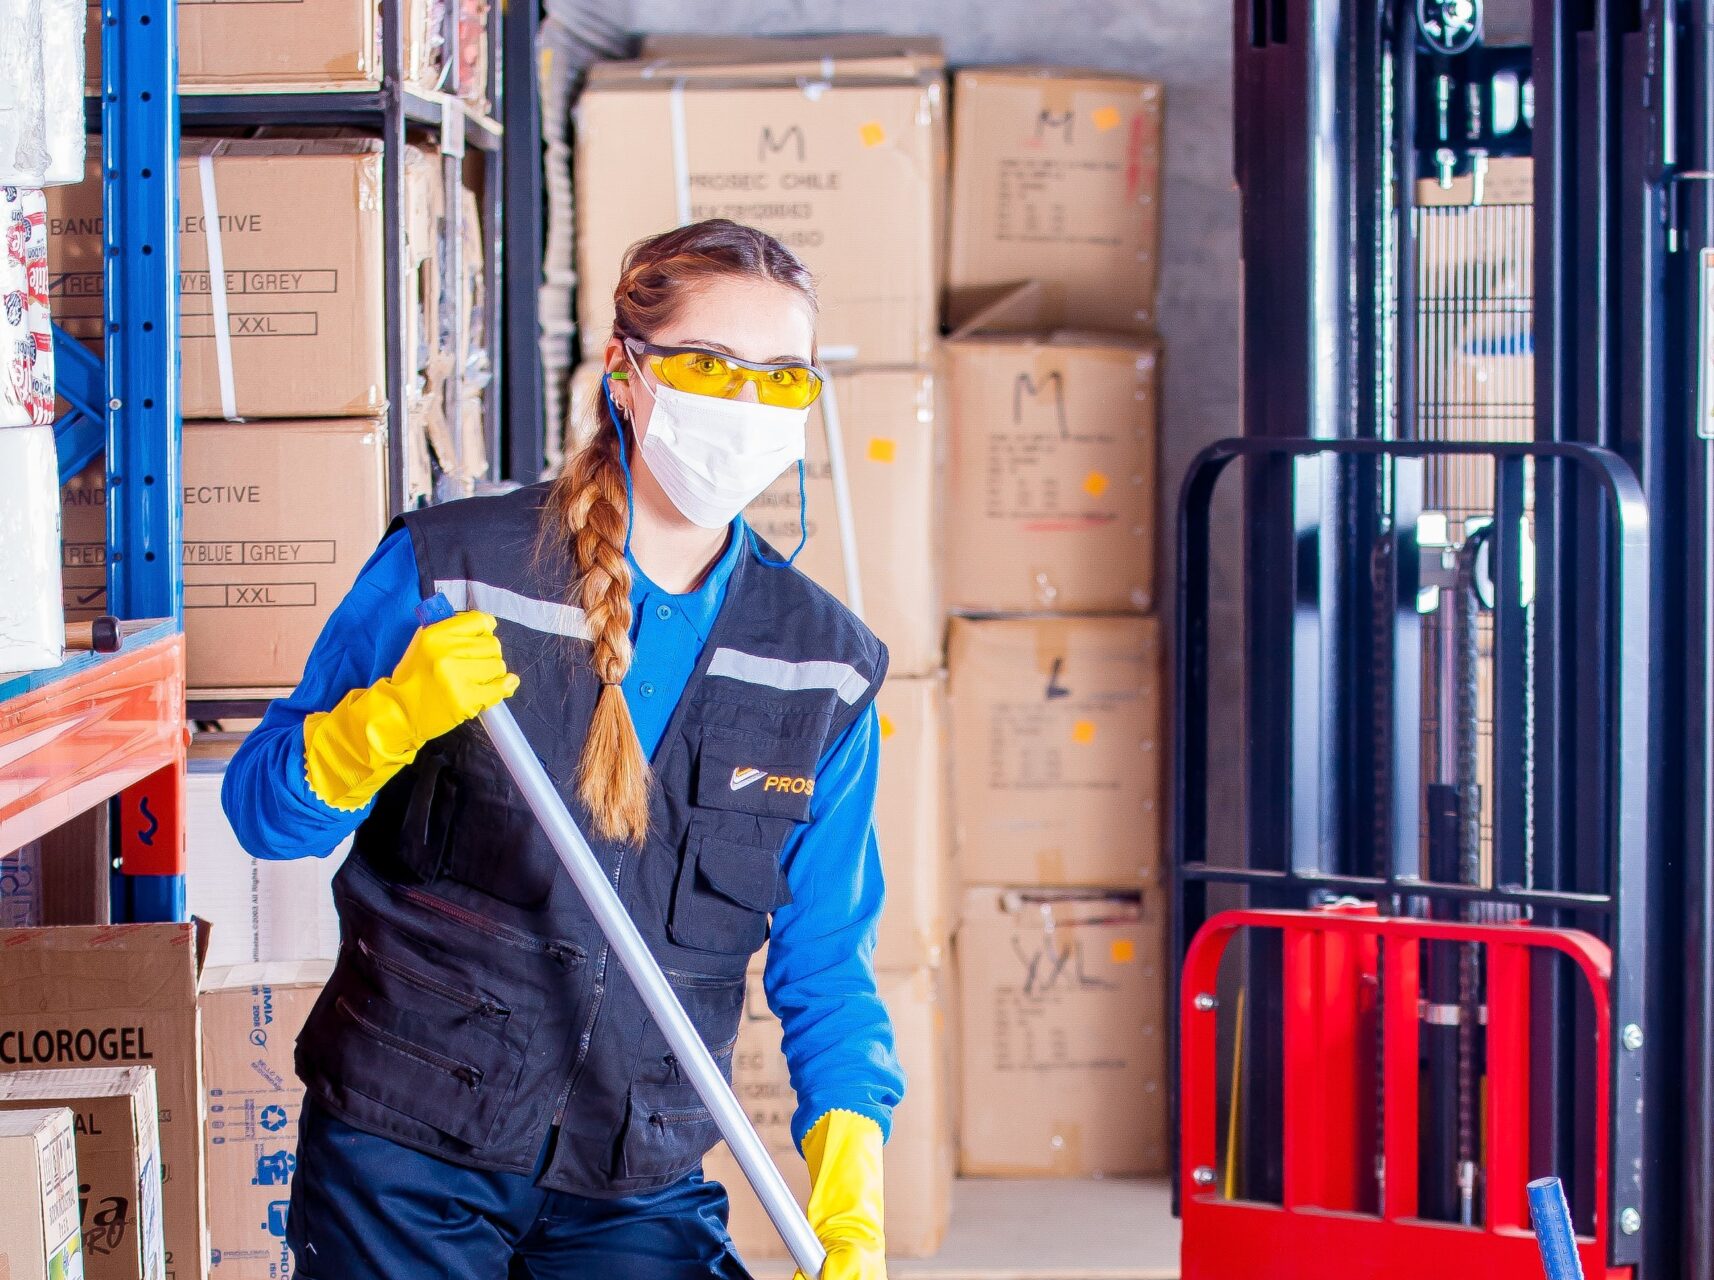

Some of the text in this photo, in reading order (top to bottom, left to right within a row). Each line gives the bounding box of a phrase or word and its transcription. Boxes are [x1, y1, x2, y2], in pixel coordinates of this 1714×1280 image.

[758, 124, 806, 162] M
[780, 171, 841, 190] CHILE
[252, 273, 303, 290] GREY
[238, 317, 278, 333] XXL
[1012, 370, 1071, 440] M
[250, 545, 302, 561] GREY
[236, 588, 276, 603] XXL
[1045, 657, 1071, 699] L
[0, 1026, 154, 1064] CLOROGEL
